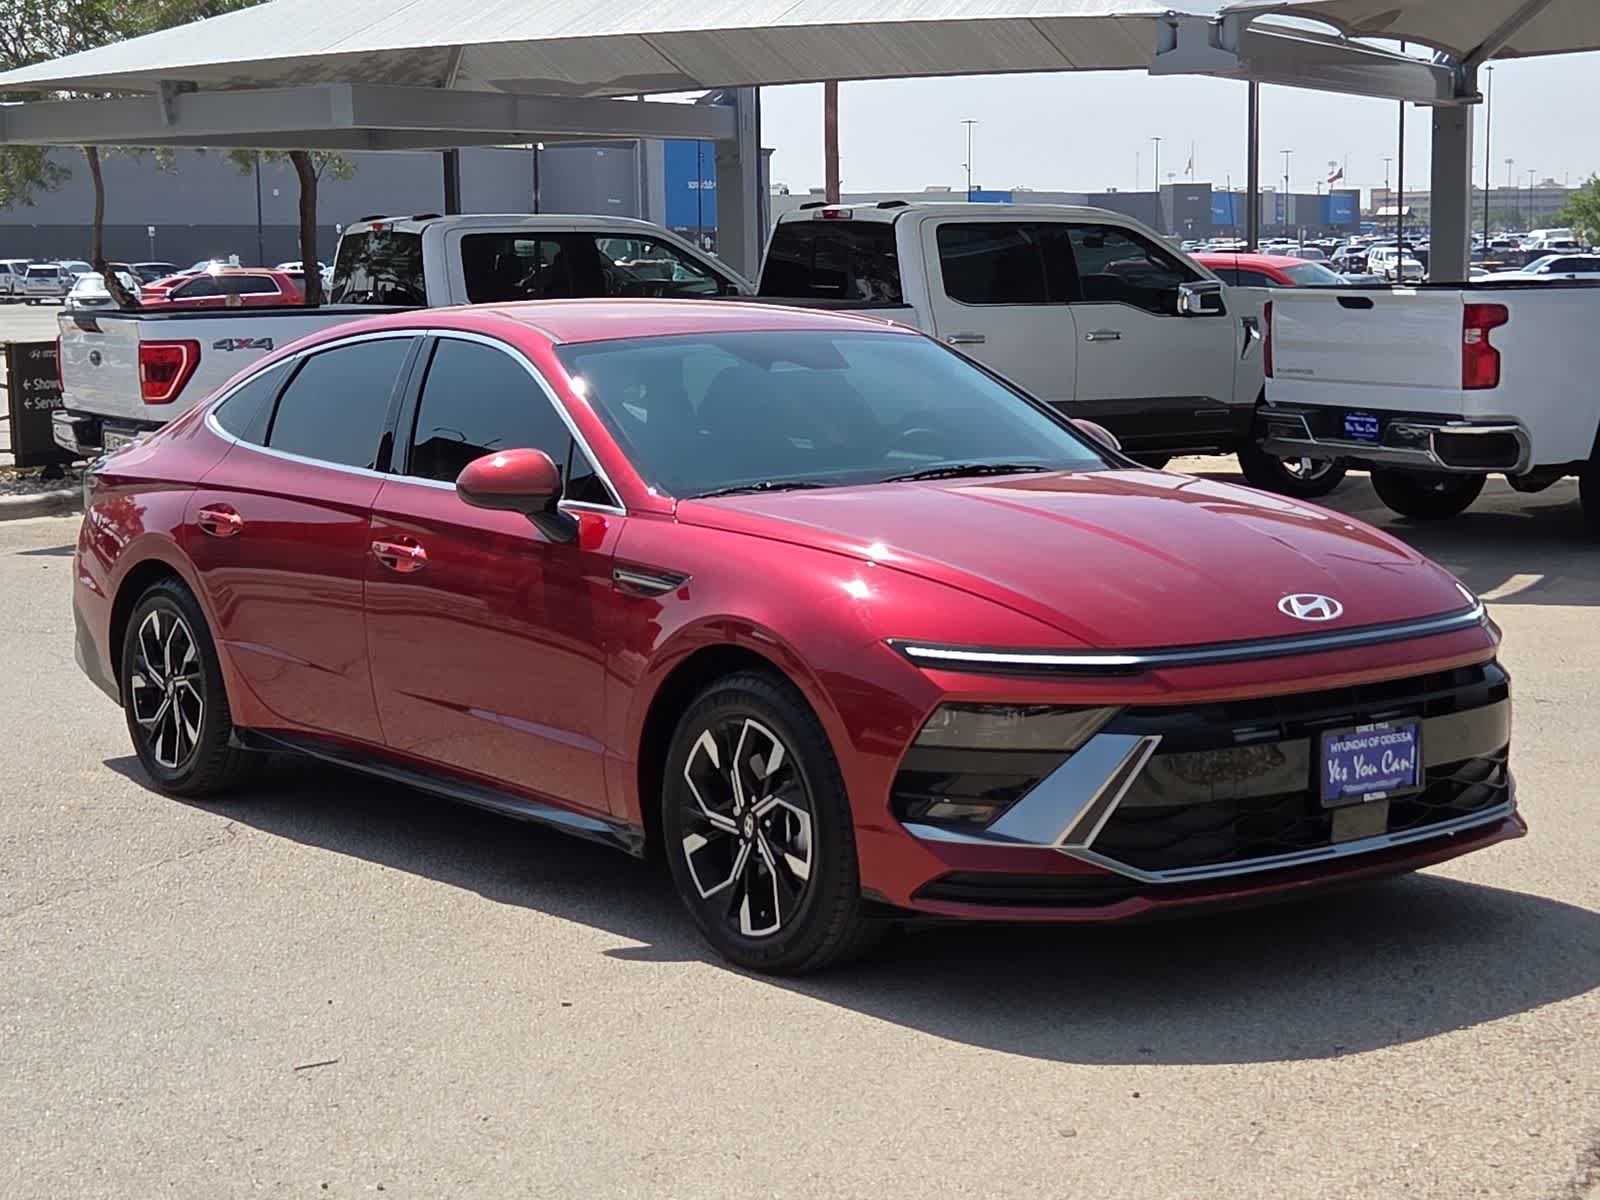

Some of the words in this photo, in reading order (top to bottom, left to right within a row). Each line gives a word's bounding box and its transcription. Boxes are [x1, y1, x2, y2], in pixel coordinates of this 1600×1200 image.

[1331, 738, 1367, 752] HYUNDAI
[1368, 735, 1380, 747] OF
[1327, 758, 1348, 784] Yes
[1352, 753, 1378, 780] You
[1381, 745, 1415, 774] Can!
